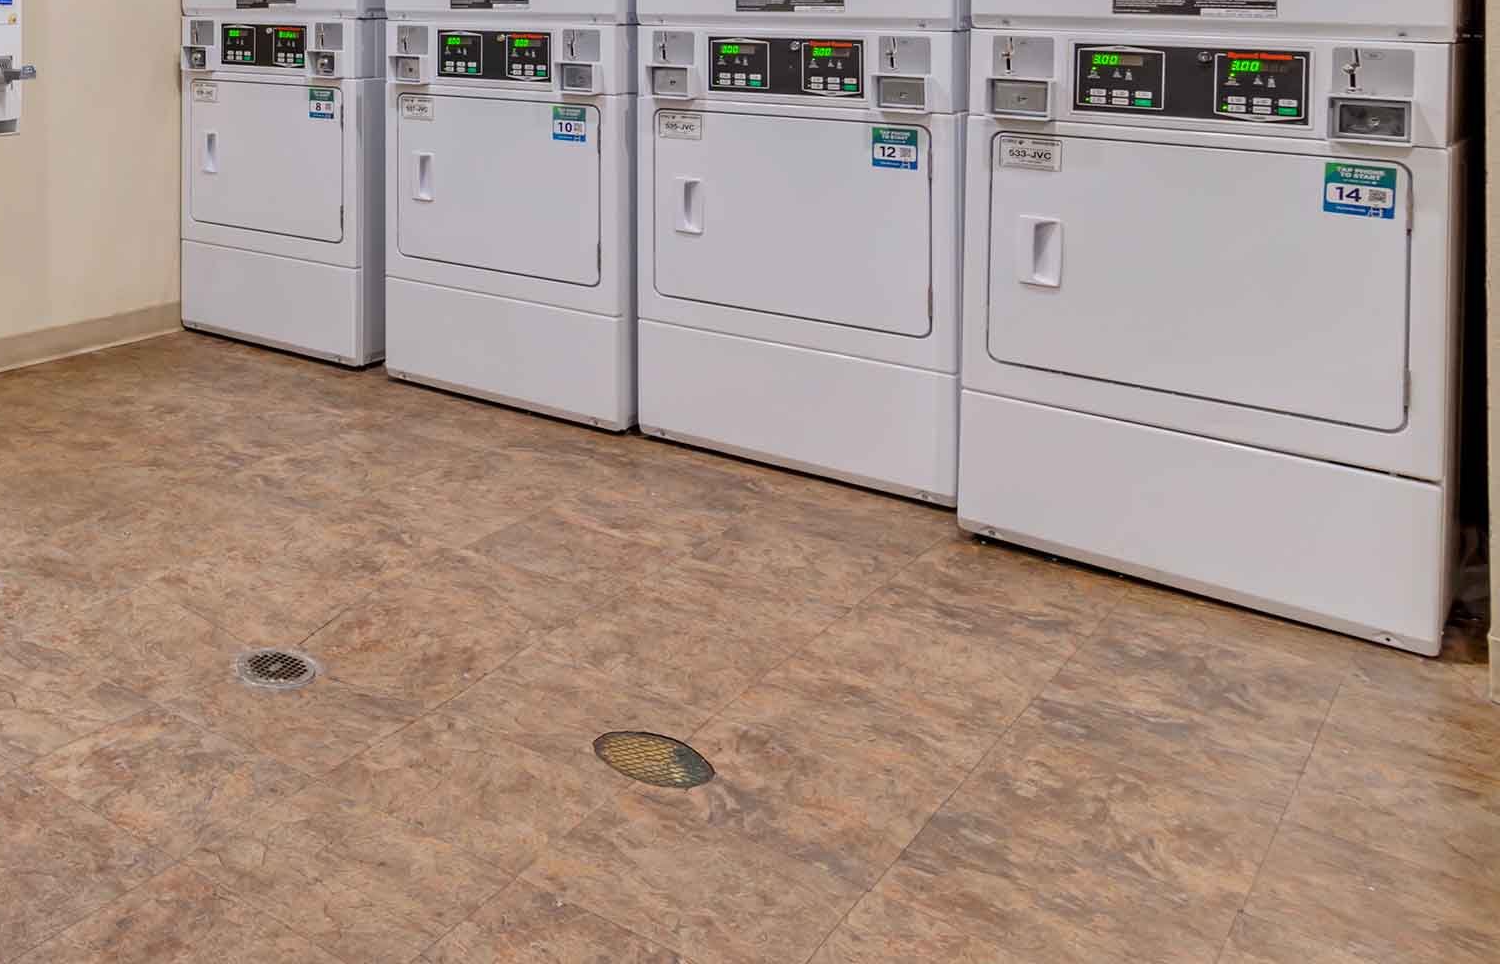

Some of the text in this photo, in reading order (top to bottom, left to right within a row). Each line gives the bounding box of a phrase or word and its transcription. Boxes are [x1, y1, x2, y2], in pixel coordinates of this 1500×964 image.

[315, 102, 322, 111] 8
[558, 122, 572, 133] 10
[879, 146, 896, 158] 12
[1009, 148, 1051, 161] 533-JVC
[1352, 173, 1380, 181] START
[1335, 186, 1362, 202] 14
